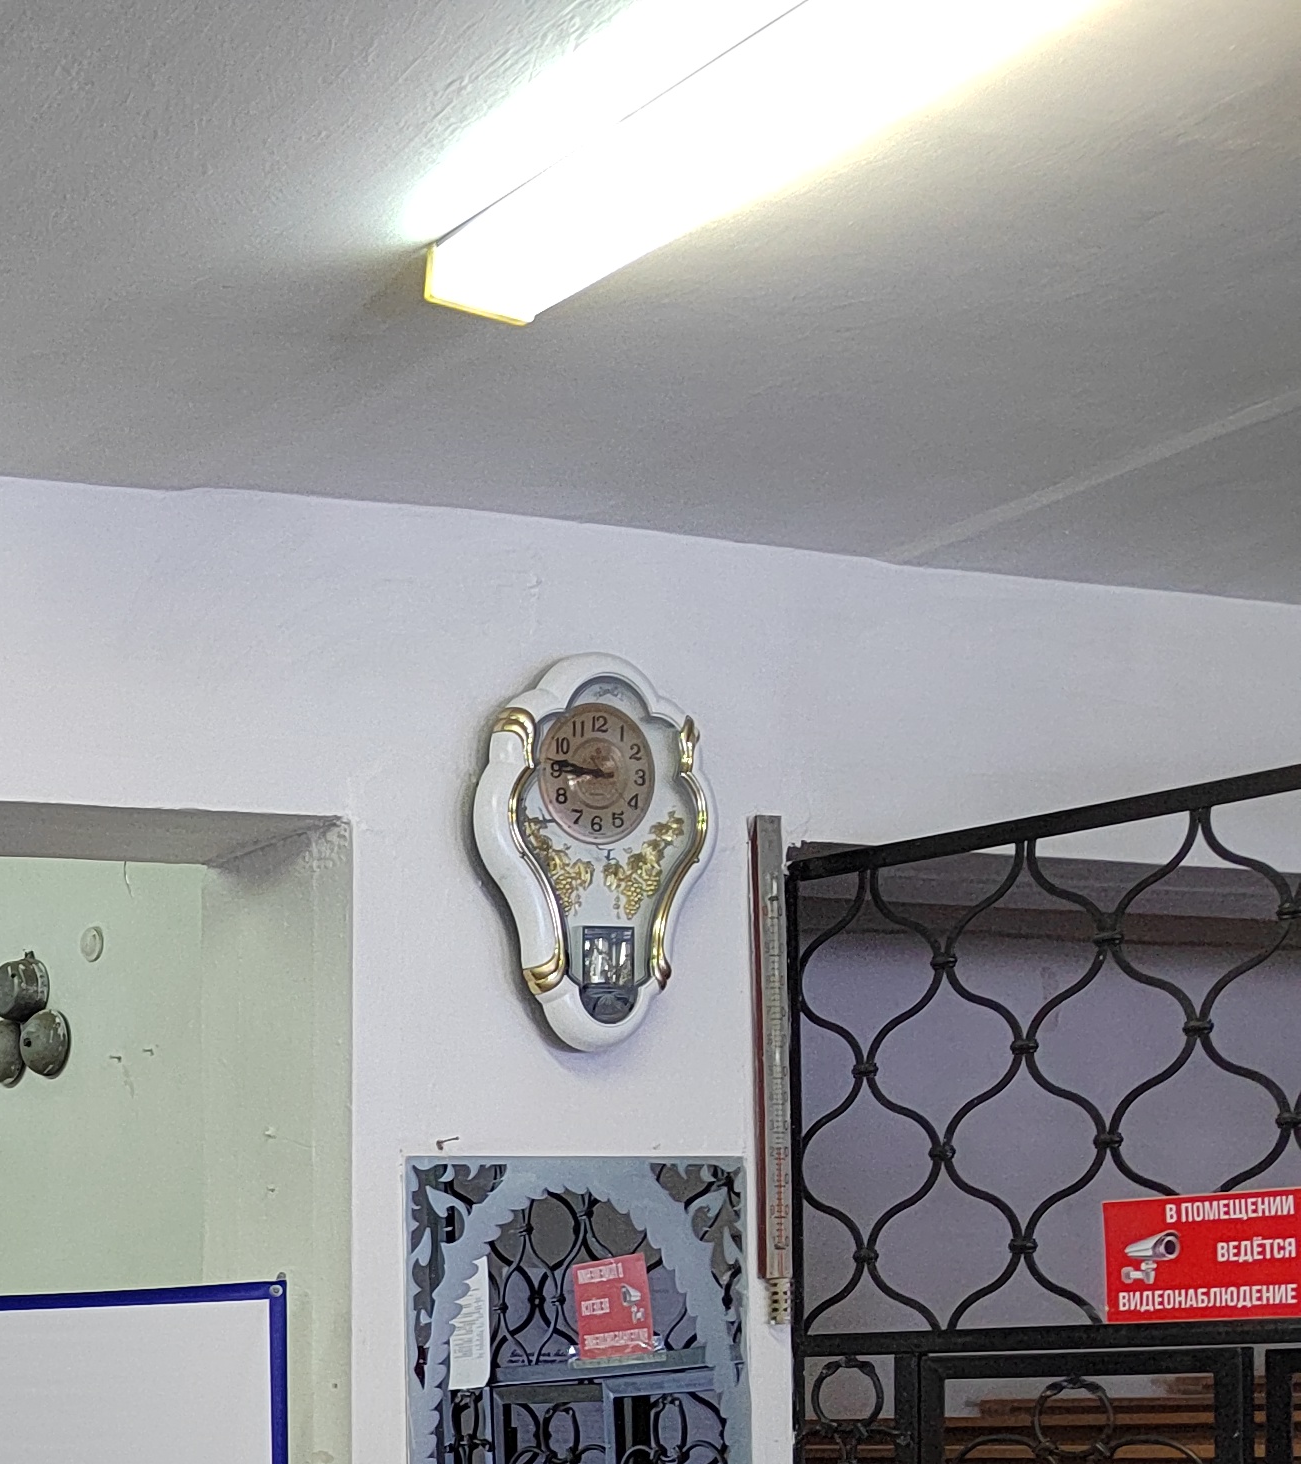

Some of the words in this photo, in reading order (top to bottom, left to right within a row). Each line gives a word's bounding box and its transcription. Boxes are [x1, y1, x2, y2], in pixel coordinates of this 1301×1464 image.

[571, 720, 585, 738] 11
[591, 715, 609, 733] 12
[619, 724, 625, 742] 1
[555, 737, 570, 754] 10
[629, 743, 642, 761] 2
[634, 769, 646, 786] 3
[555, 787, 568, 804] 8
[627, 793, 639, 810] 4
[571, 808, 583, 824] 7
[590, 816, 603, 832] 6
[612, 810, 625, 828] 5
[1165, 1204, 1177, 1223] В
[1181, 1195, 1295, 1223] ПОМЕЩЕНИИ
[1217, 1237, 1296, 1262] ВЕДЁТСЯ
[1119, 1284, 1298, 1312] ВИДЕОНАБЛЮДЕНИЕ
